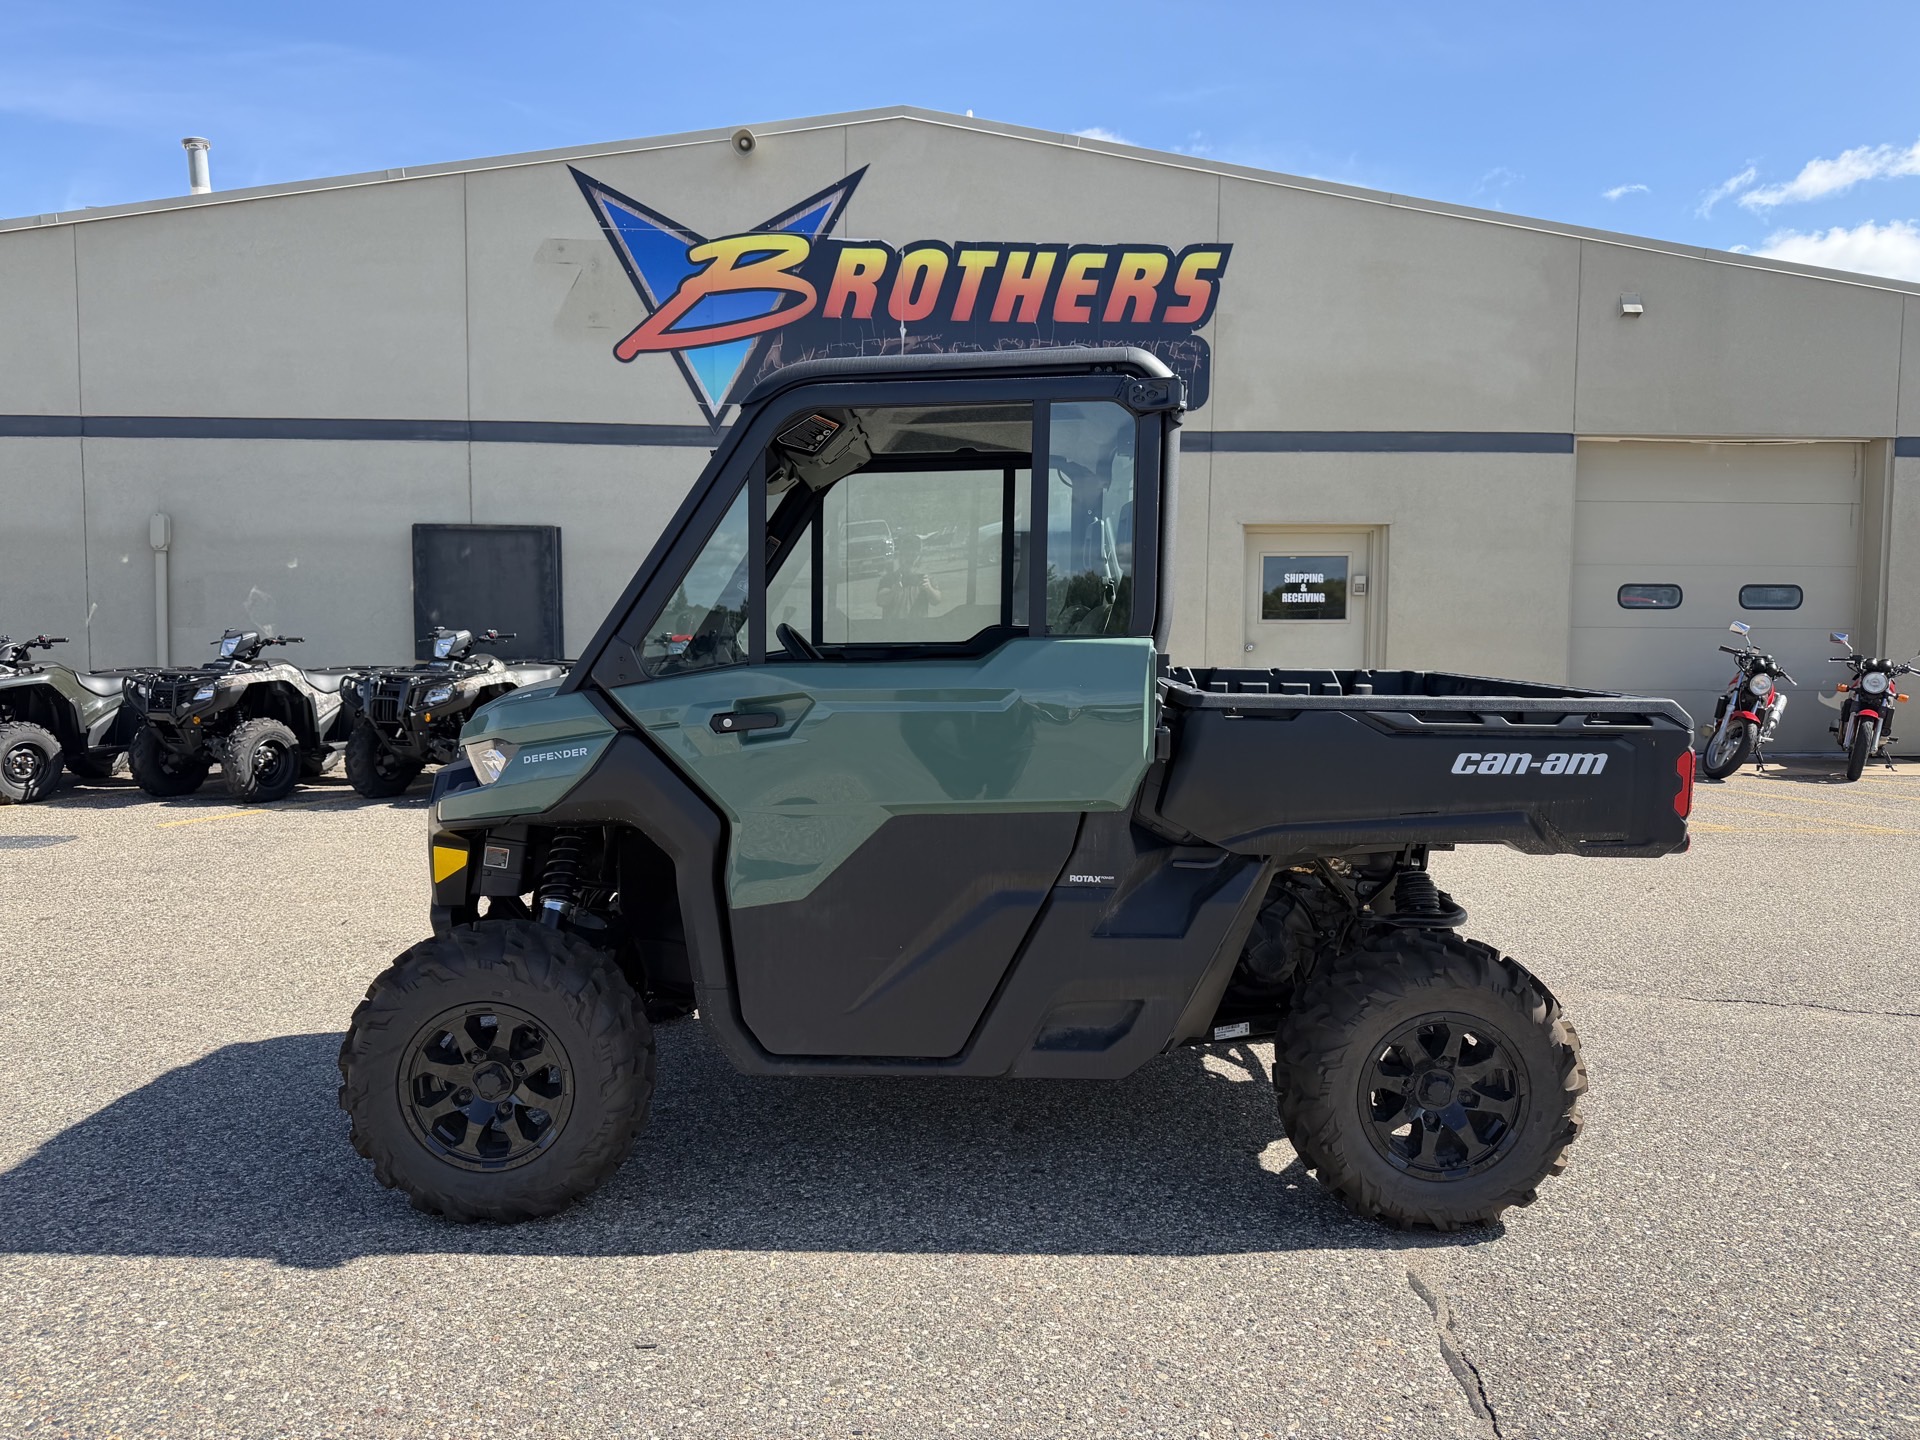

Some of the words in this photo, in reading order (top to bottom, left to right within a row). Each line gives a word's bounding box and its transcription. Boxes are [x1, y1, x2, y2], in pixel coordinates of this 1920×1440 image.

[612, 233, 1225, 363] BROTHERS
[1284, 573, 1324, 583] SHIPPING
[1300, 583, 1307, 592] &
[1282, 593, 1325, 602] RECEIVING
[523, 747, 588, 764] DEFENDER
[1451, 752, 1608, 775] can-am
[1070, 874, 1101, 882] ROTAX
